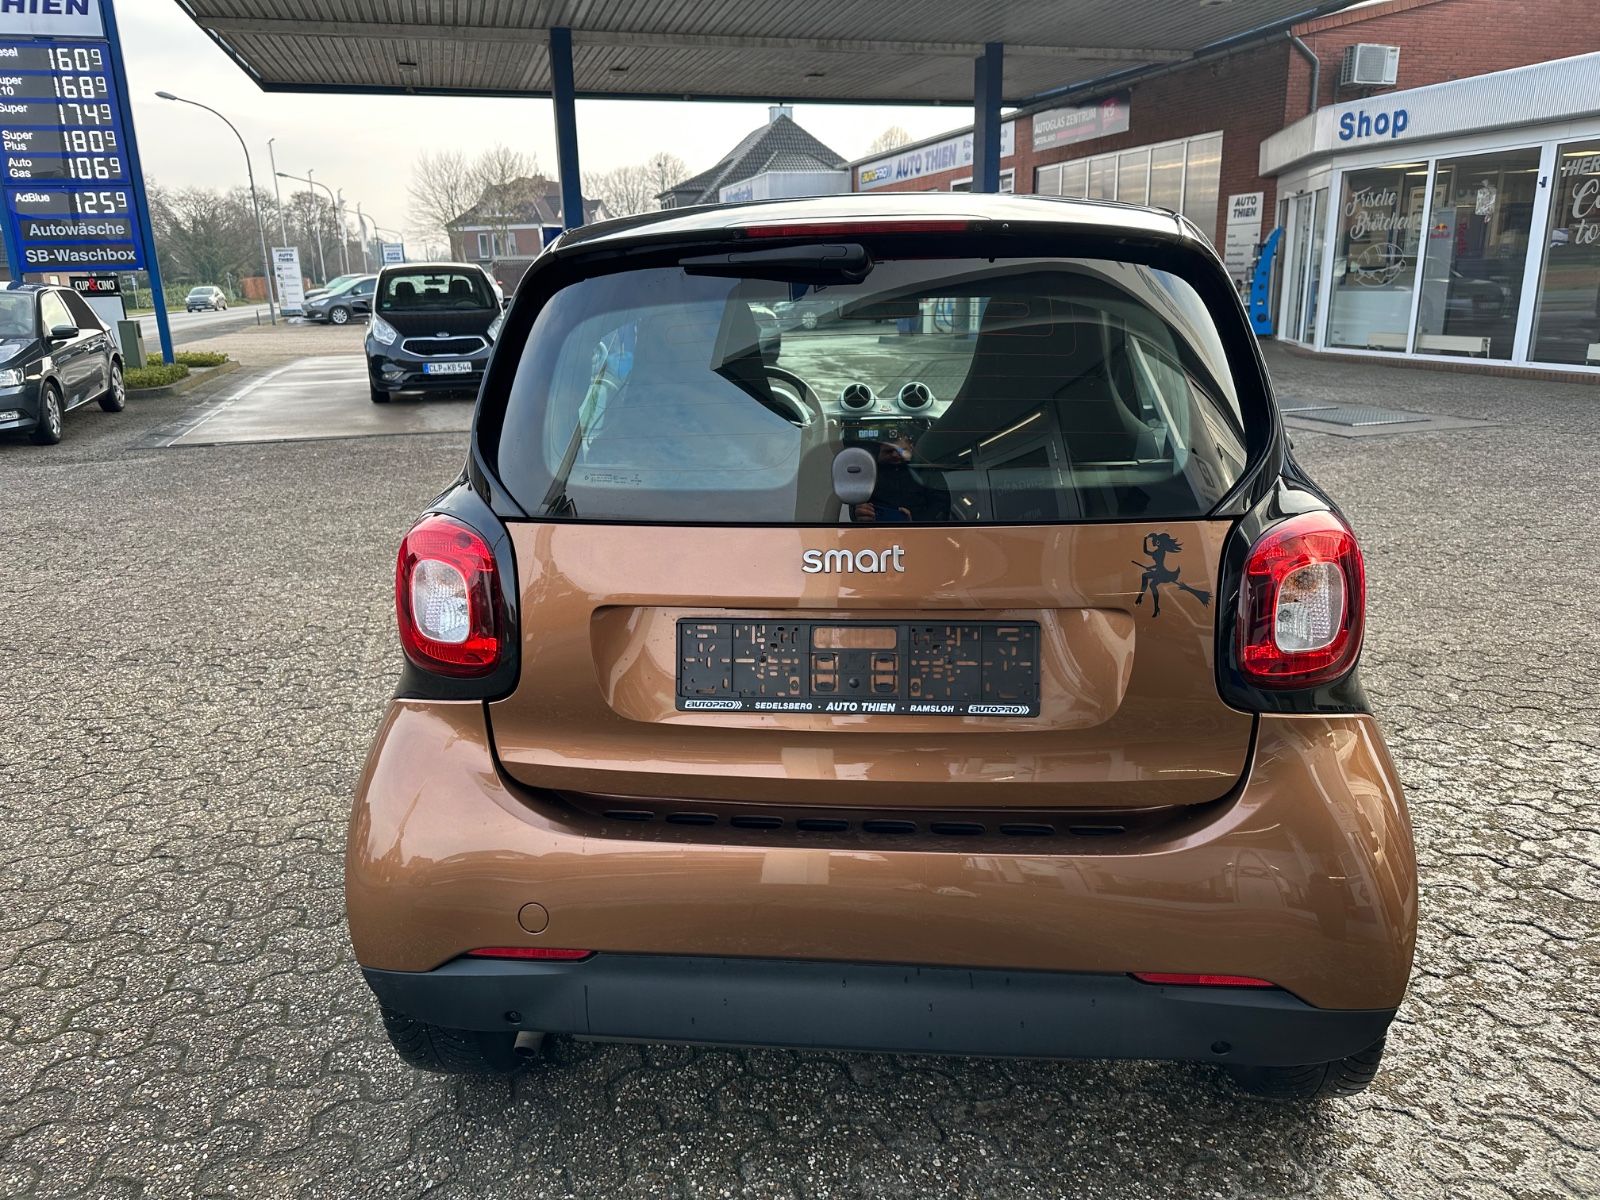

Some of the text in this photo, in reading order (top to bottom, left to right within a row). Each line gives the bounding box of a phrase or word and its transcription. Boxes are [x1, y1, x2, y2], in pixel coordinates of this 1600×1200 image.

[48, 48, 102, 71] 1609
[54, 76, 107, 99] 1689
[0, 102, 28, 114] Super
[58, 103, 112, 125] 1749
[1066, 107, 1097, 126] ZENTRUM
[1338, 109, 1408, 141] Shop
[2, 130, 33, 142] Super
[63, 130, 117, 152] 1809
[3, 141, 28, 151] Plus
[8, 157, 32, 167] Auto
[68, 157, 121, 179] 1069
[896, 153, 922, 180] AUTO
[925, 143, 958, 173] THIEN
[9, 168, 32, 178] Gas
[15, 192, 51, 203] AdBlue
[74, 191, 128, 214] 1259
[1235, 195, 1257, 207] AUTO
[1345, 186, 1396, 217] Frische
[1233, 207, 1257, 219] THIEN
[29, 222, 125, 237] Autowäsche
[25, 248, 137, 263] SB-Waschbox
[74, 278, 116, 292] CUP&CINO
[802, 545, 905, 573] smart
[755, 701, 813, 710] SEDELSBERG
[826, 702, 858, 712] AUTO
[862, 703, 896, 713] THIEN
[910, 705, 954, 713] RAMSLOH
